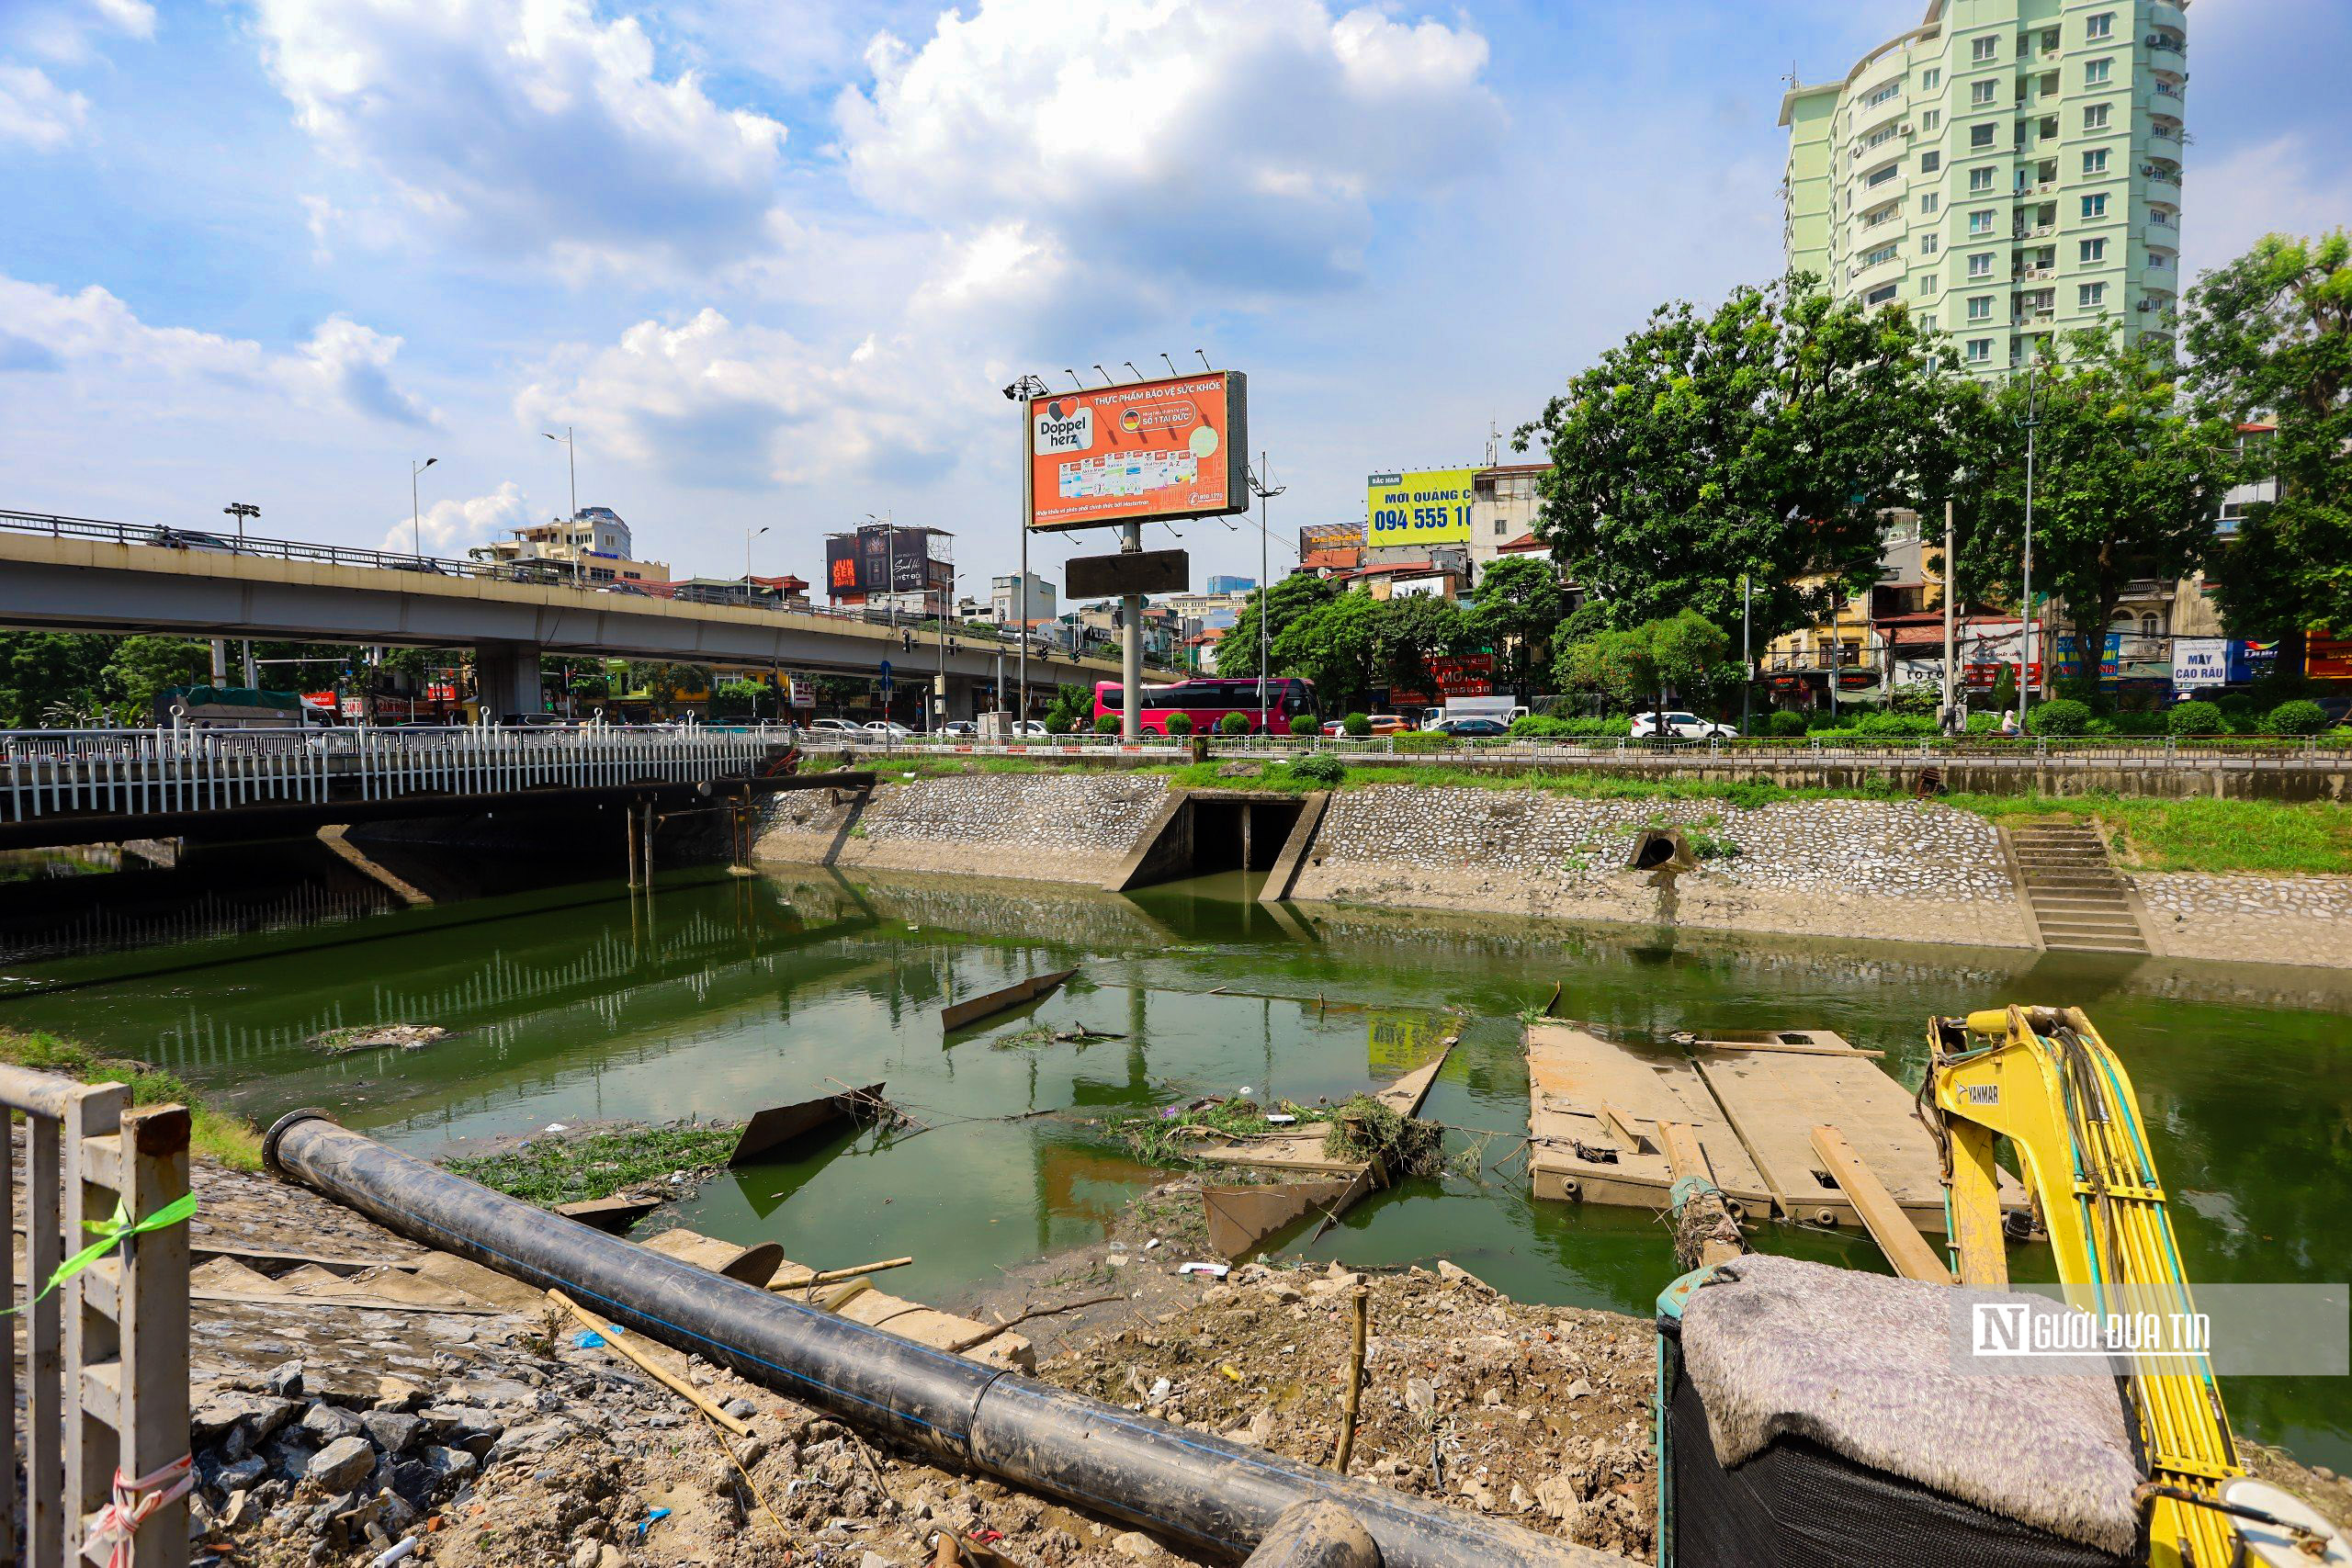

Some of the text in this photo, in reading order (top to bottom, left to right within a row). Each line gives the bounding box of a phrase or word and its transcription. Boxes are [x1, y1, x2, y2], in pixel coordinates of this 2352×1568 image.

[1094, 396, 1117, 406] THỰC
[1165, 387, 1175, 397] VỆ
[1177, 384, 1194, 395] SỨC
[1143, 415, 1152, 424] SỐ
[1172, 412, 1189, 422] ĐỨC
[1041, 417, 1085, 435] Doppel
[1050, 434, 1077, 446] herz
[1385, 491, 1408, 503] MỜI
[1414, 487, 1458, 503] QUẢNG
[1374, 509, 1408, 532] 094
[1414, 507, 1447, 528] 555
[834, 559, 854, 570] JUN
[833, 568, 854, 577] GER
[2188, 653, 2211, 665] MÁY
[2176, 666, 2222, 680] CẠO RÂU
[1968, 1085, 1998, 1103] YANMAR
